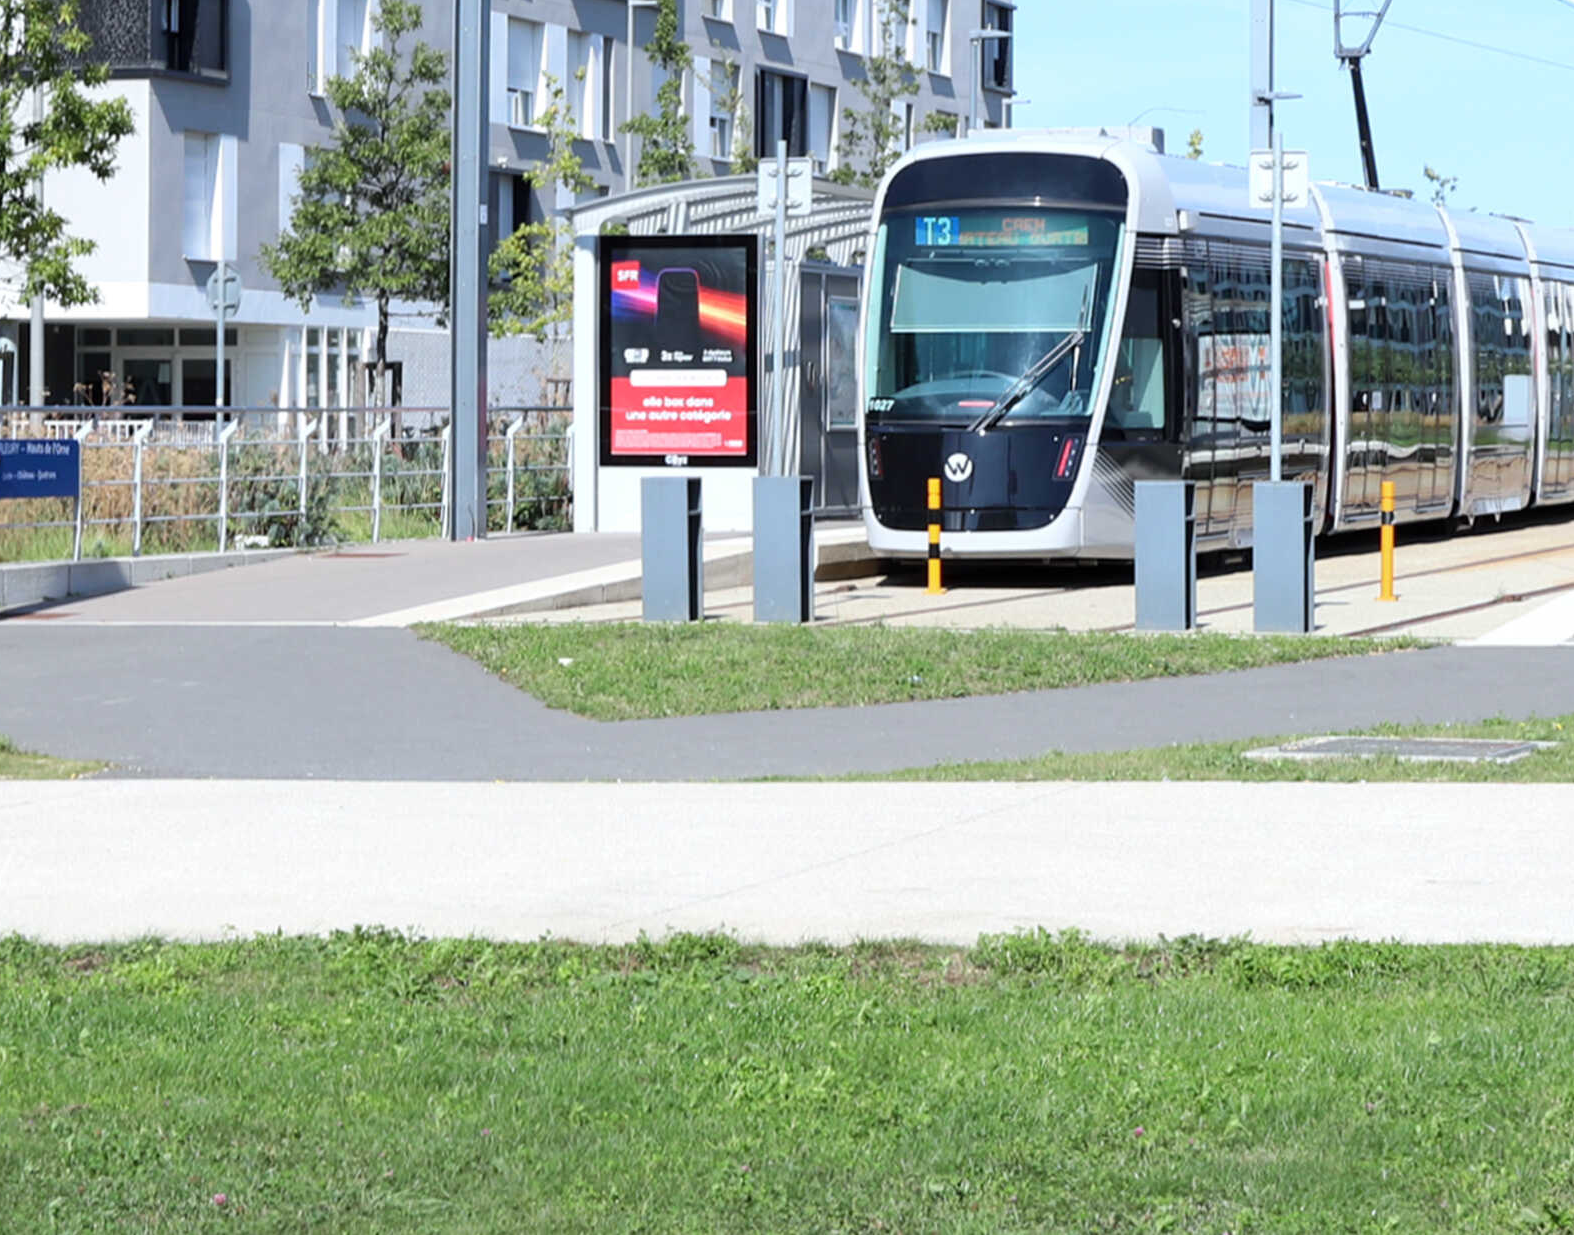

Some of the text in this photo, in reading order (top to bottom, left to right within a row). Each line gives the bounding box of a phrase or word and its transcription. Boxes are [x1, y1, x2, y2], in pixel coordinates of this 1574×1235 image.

[923, 216, 952, 246] T3
[1001, 217, 1046, 231] CAEN
[616, 269, 640, 282] SFR
[664, 395, 685, 408] box
[685, 395, 714, 408] dans
[625, 409, 732, 424] une autre catégorie
